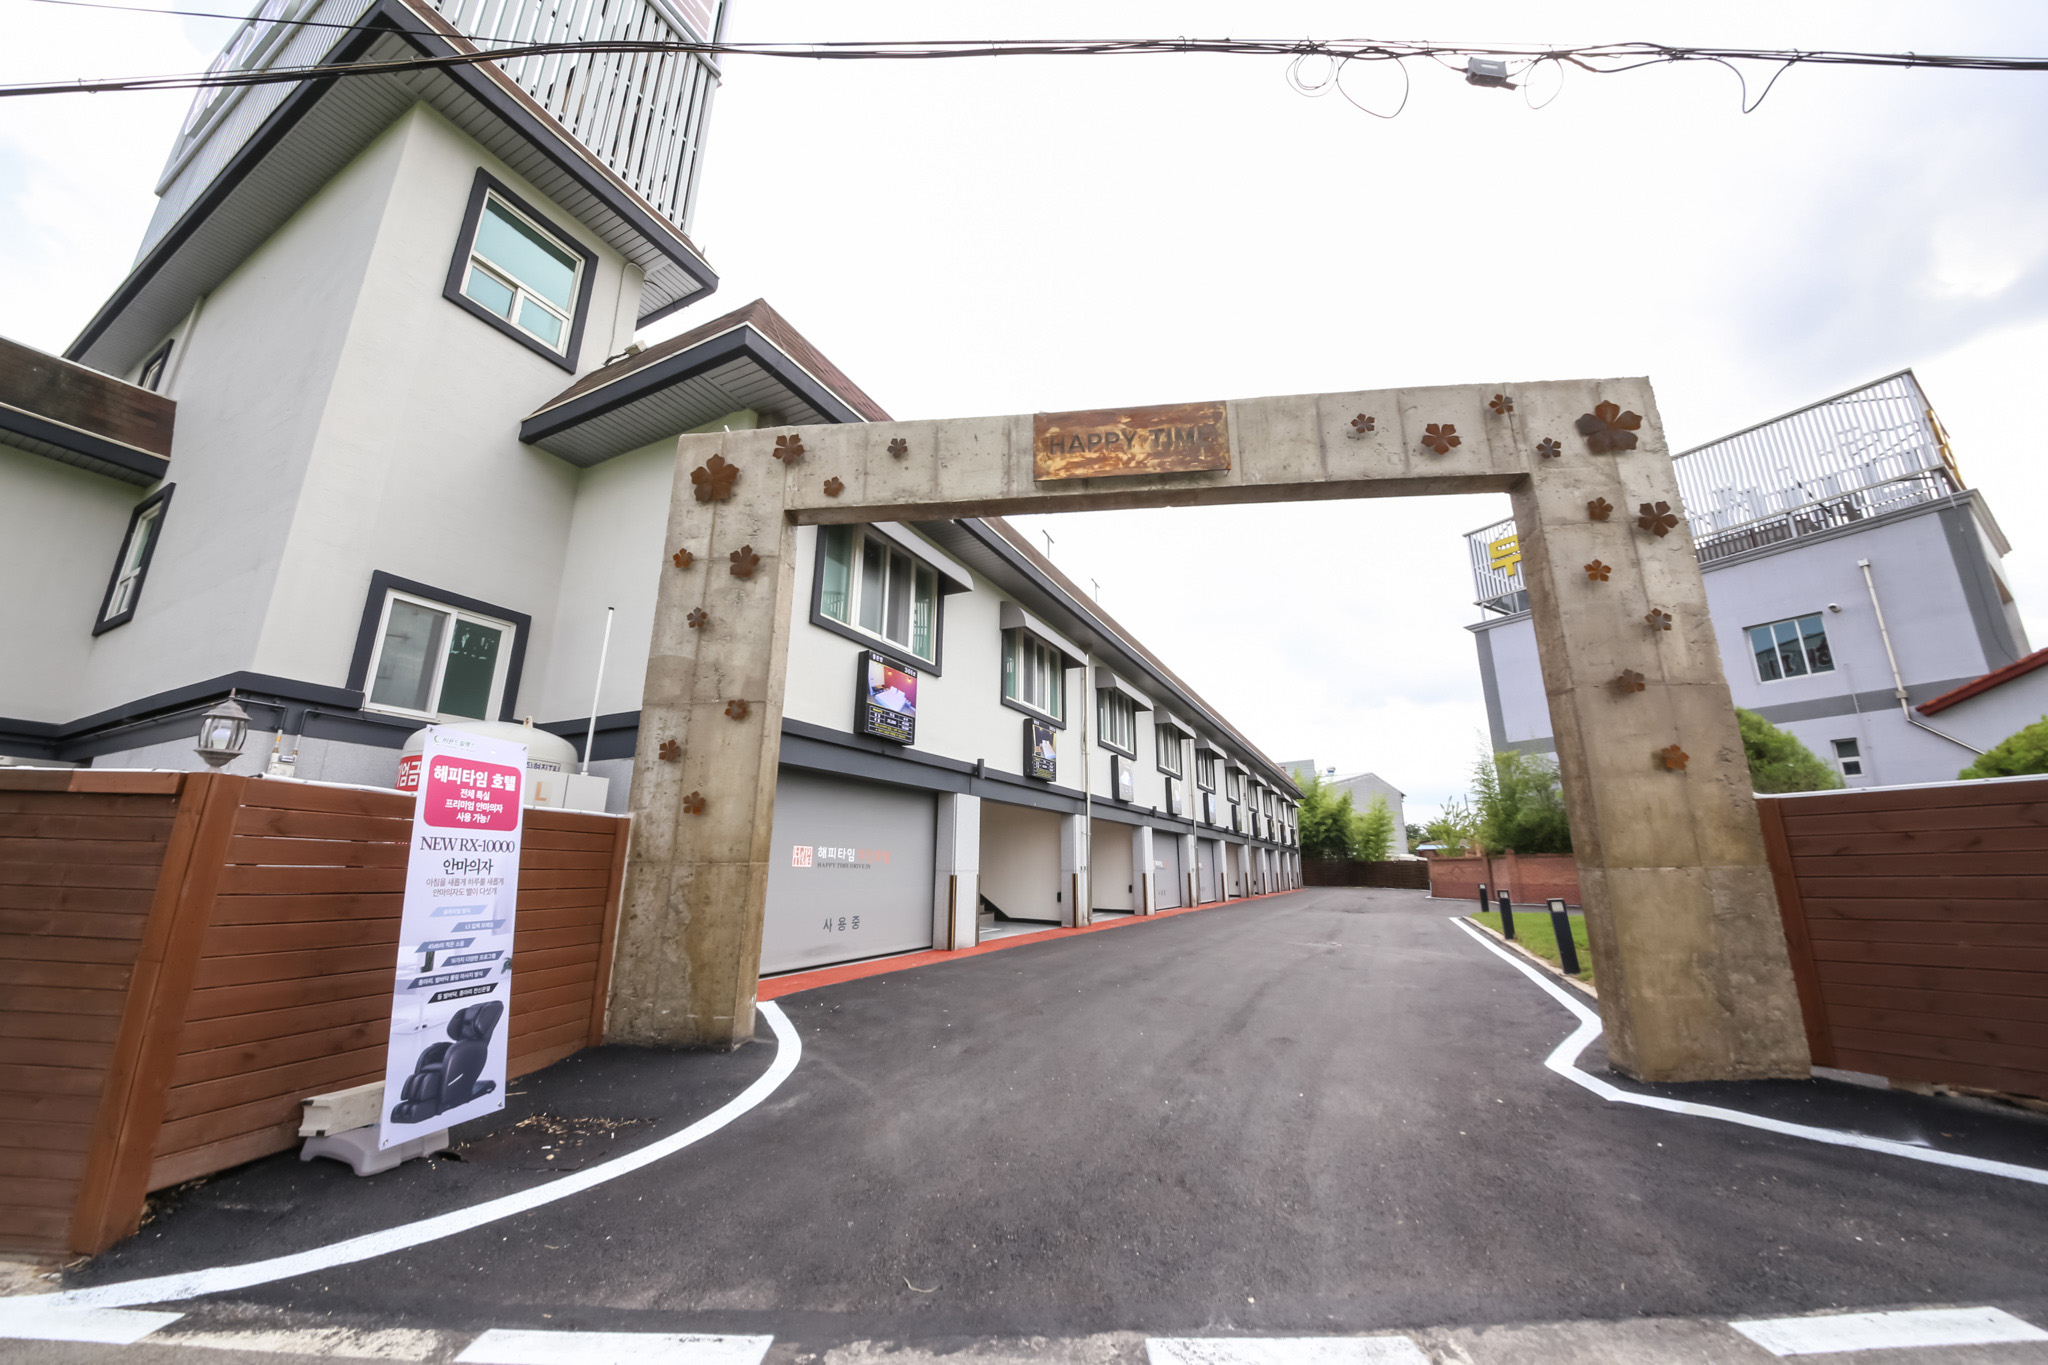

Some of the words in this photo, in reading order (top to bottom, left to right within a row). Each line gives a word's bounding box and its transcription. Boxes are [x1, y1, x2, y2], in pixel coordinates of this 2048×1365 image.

[1049, 429, 1138, 455] HAPPY
[434, 765, 488, 788] 해피타임
[491, 773, 516, 791] 호텔
[460, 788, 475, 799] 전체
[476, 790, 490, 801] 특실
[445, 799, 475, 811] 프리미엄
[476, 802, 503, 813] 안마의자
[456, 812, 471, 823] 사용
[472, 814, 490, 824] 가능!
[420, 836, 458, 851] NEW
[459, 838, 515, 853] RX-10000
[817, 846, 856, 862] 해피타임
[443, 858, 494, 875] 안마의자
[433, 888, 465, 897] 안마의자도
[823, 915, 860, 933] 사용중
